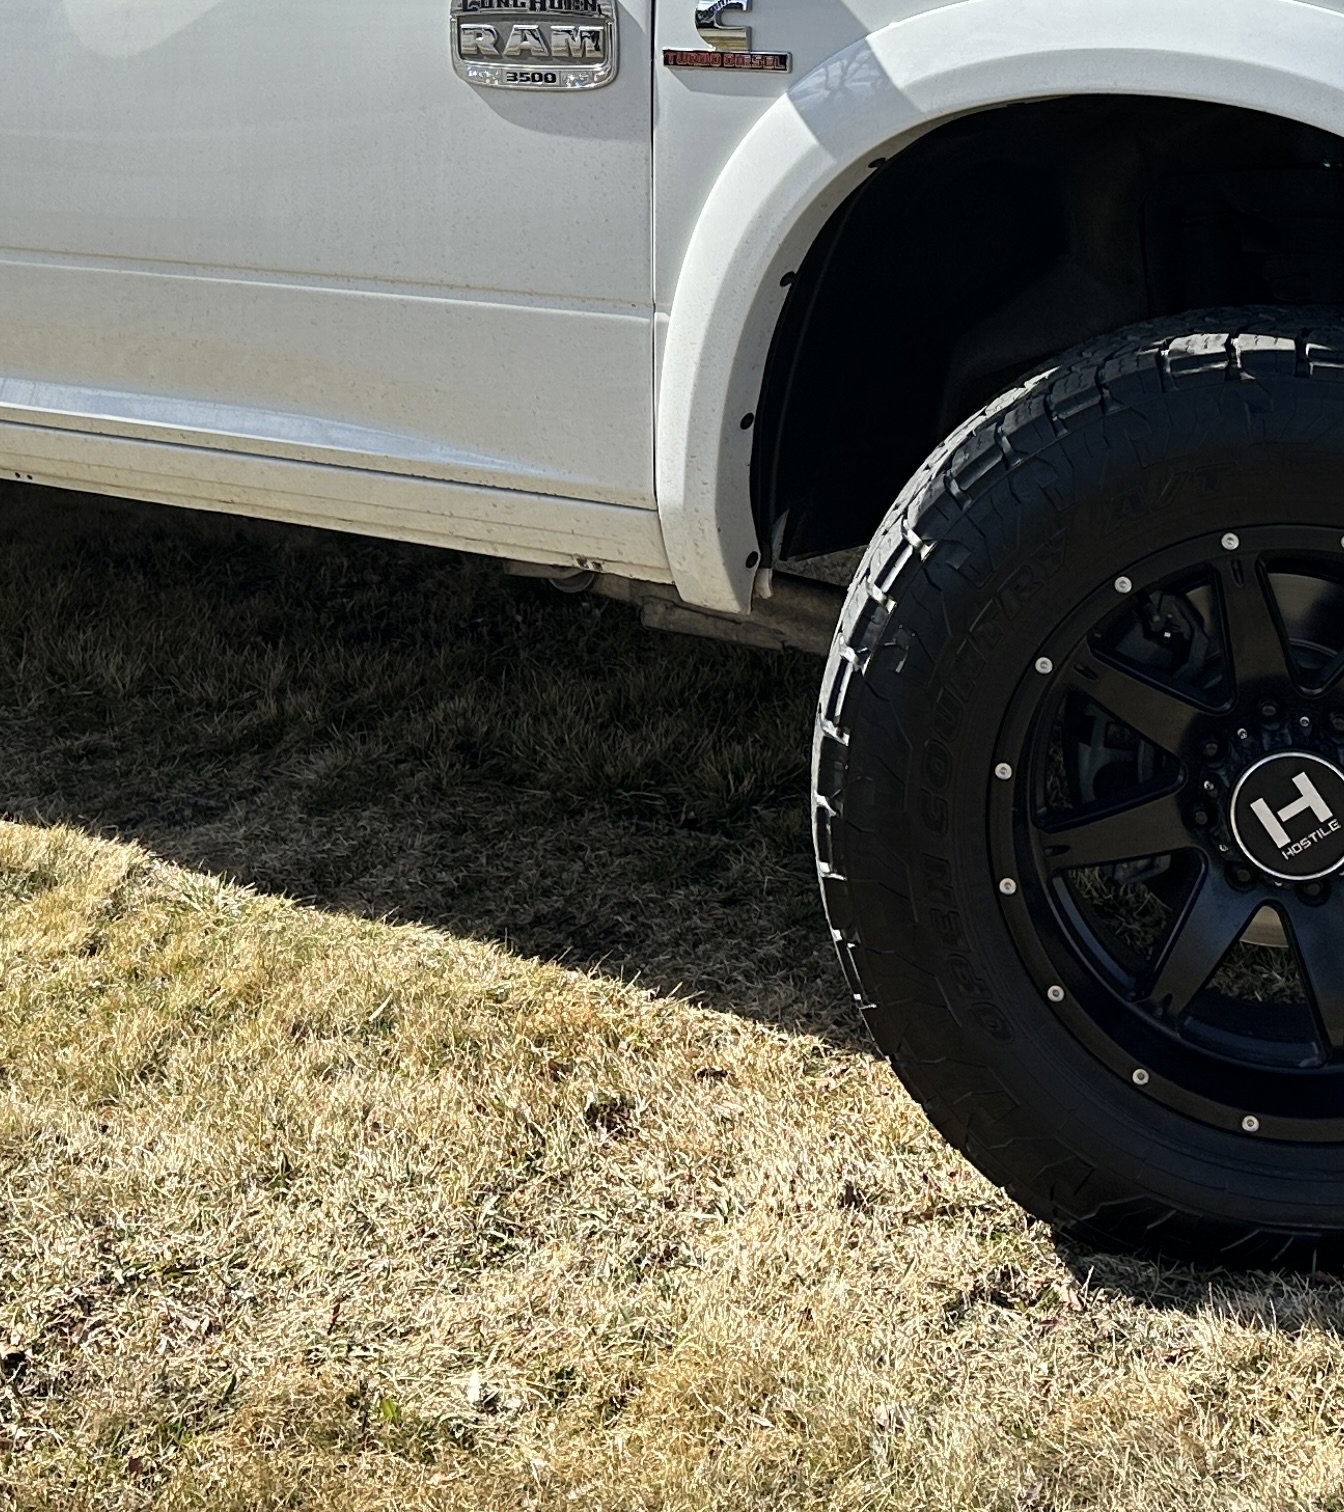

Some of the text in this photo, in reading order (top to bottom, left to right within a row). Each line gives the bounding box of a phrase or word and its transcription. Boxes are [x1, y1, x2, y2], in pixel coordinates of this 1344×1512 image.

[460, 24, 604, 57] RAM
[665, 51, 722, 67] TURBO
[506, 71, 557, 84] 3500
[1281, 818, 1342, 860] HOSTILE
